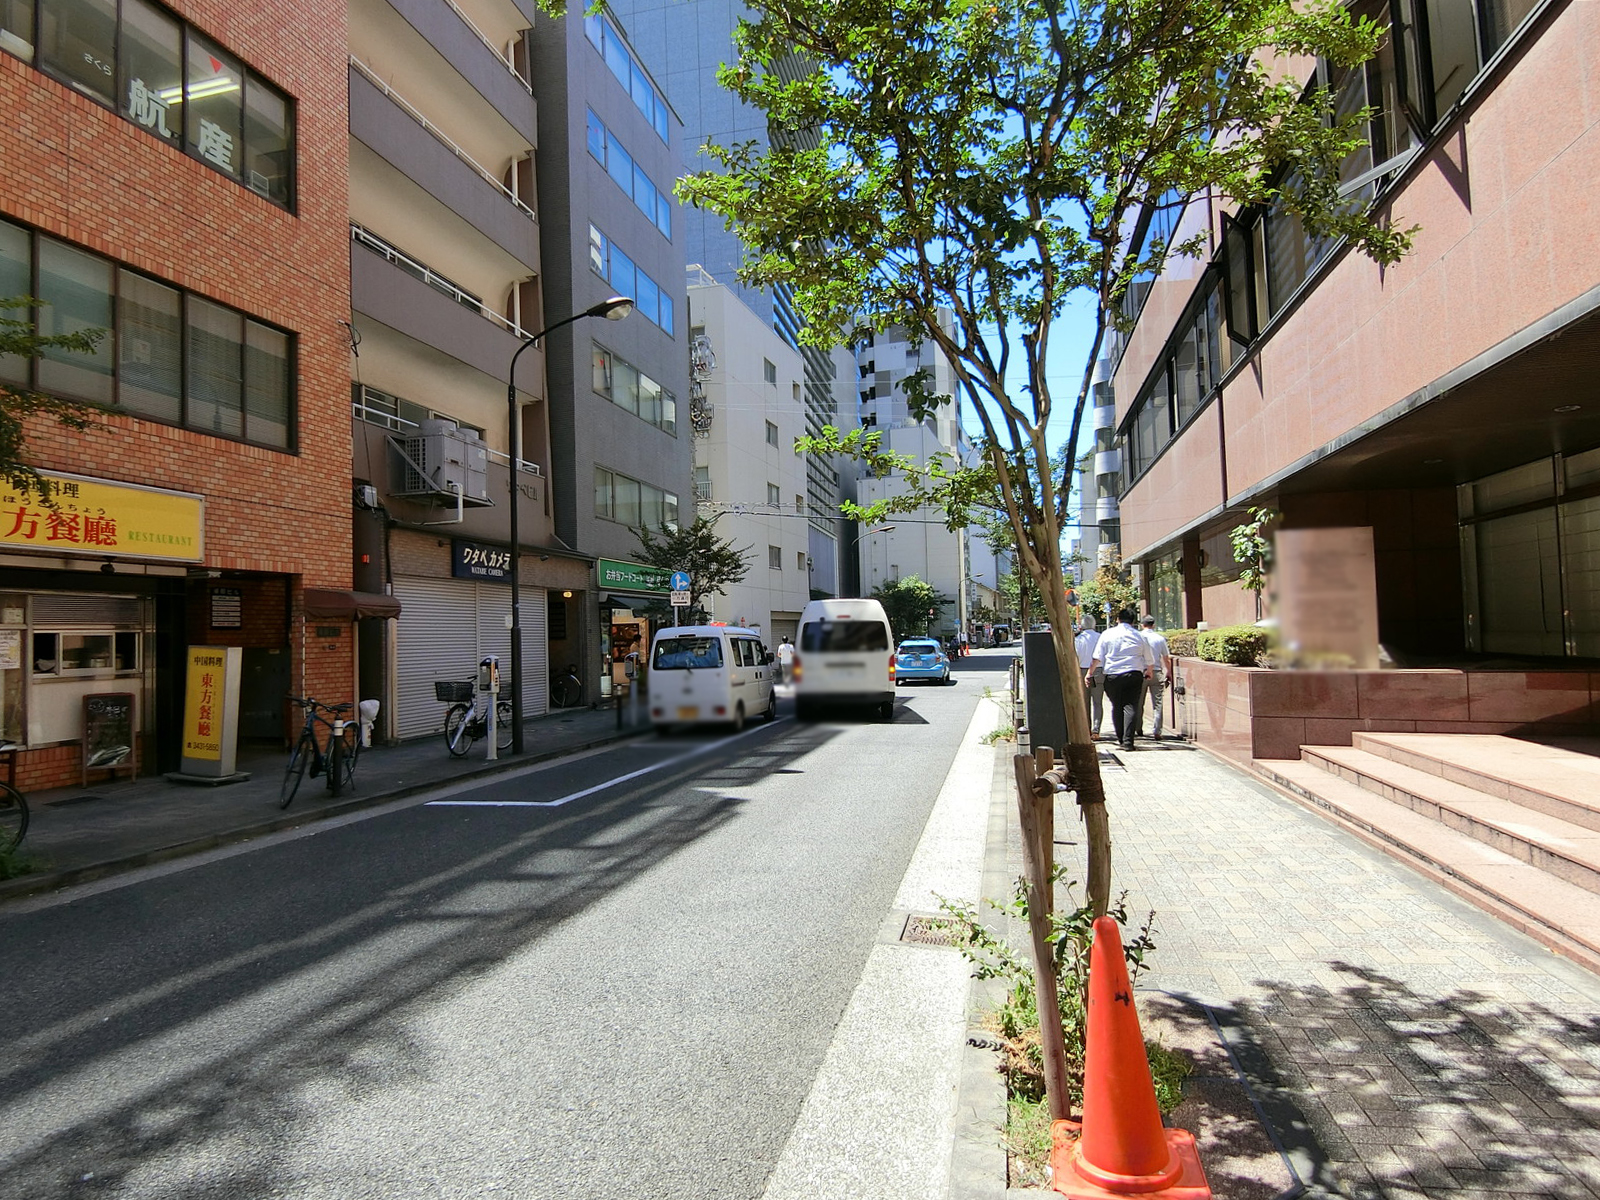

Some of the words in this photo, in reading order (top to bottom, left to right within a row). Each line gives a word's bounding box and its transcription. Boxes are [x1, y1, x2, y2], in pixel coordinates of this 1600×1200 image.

[84, 52, 112, 76] さくら
[128, 530, 192, 546] RESTAURANT
[194, 655, 223, 667] 中国料理
